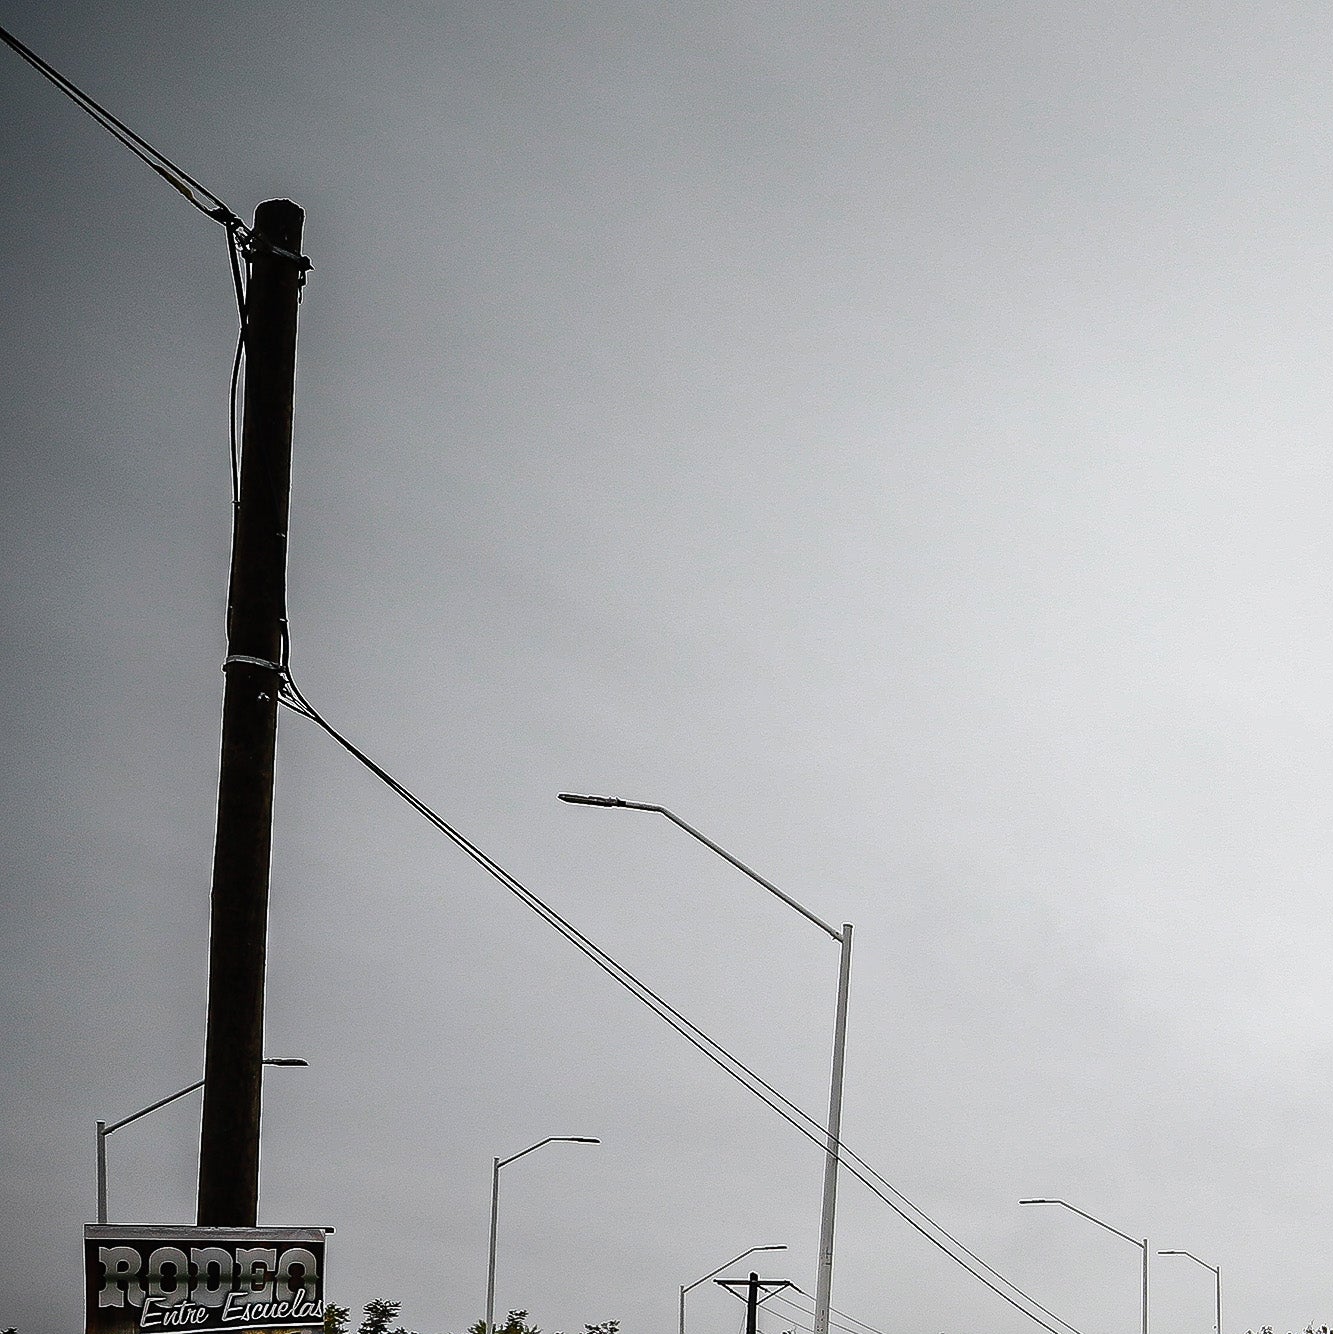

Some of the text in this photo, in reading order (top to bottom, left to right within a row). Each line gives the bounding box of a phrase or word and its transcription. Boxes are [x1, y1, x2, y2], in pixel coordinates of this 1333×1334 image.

[98, 1246, 319, 1308] RODEO
[140, 1289, 323, 1327] Entre Escuelas
